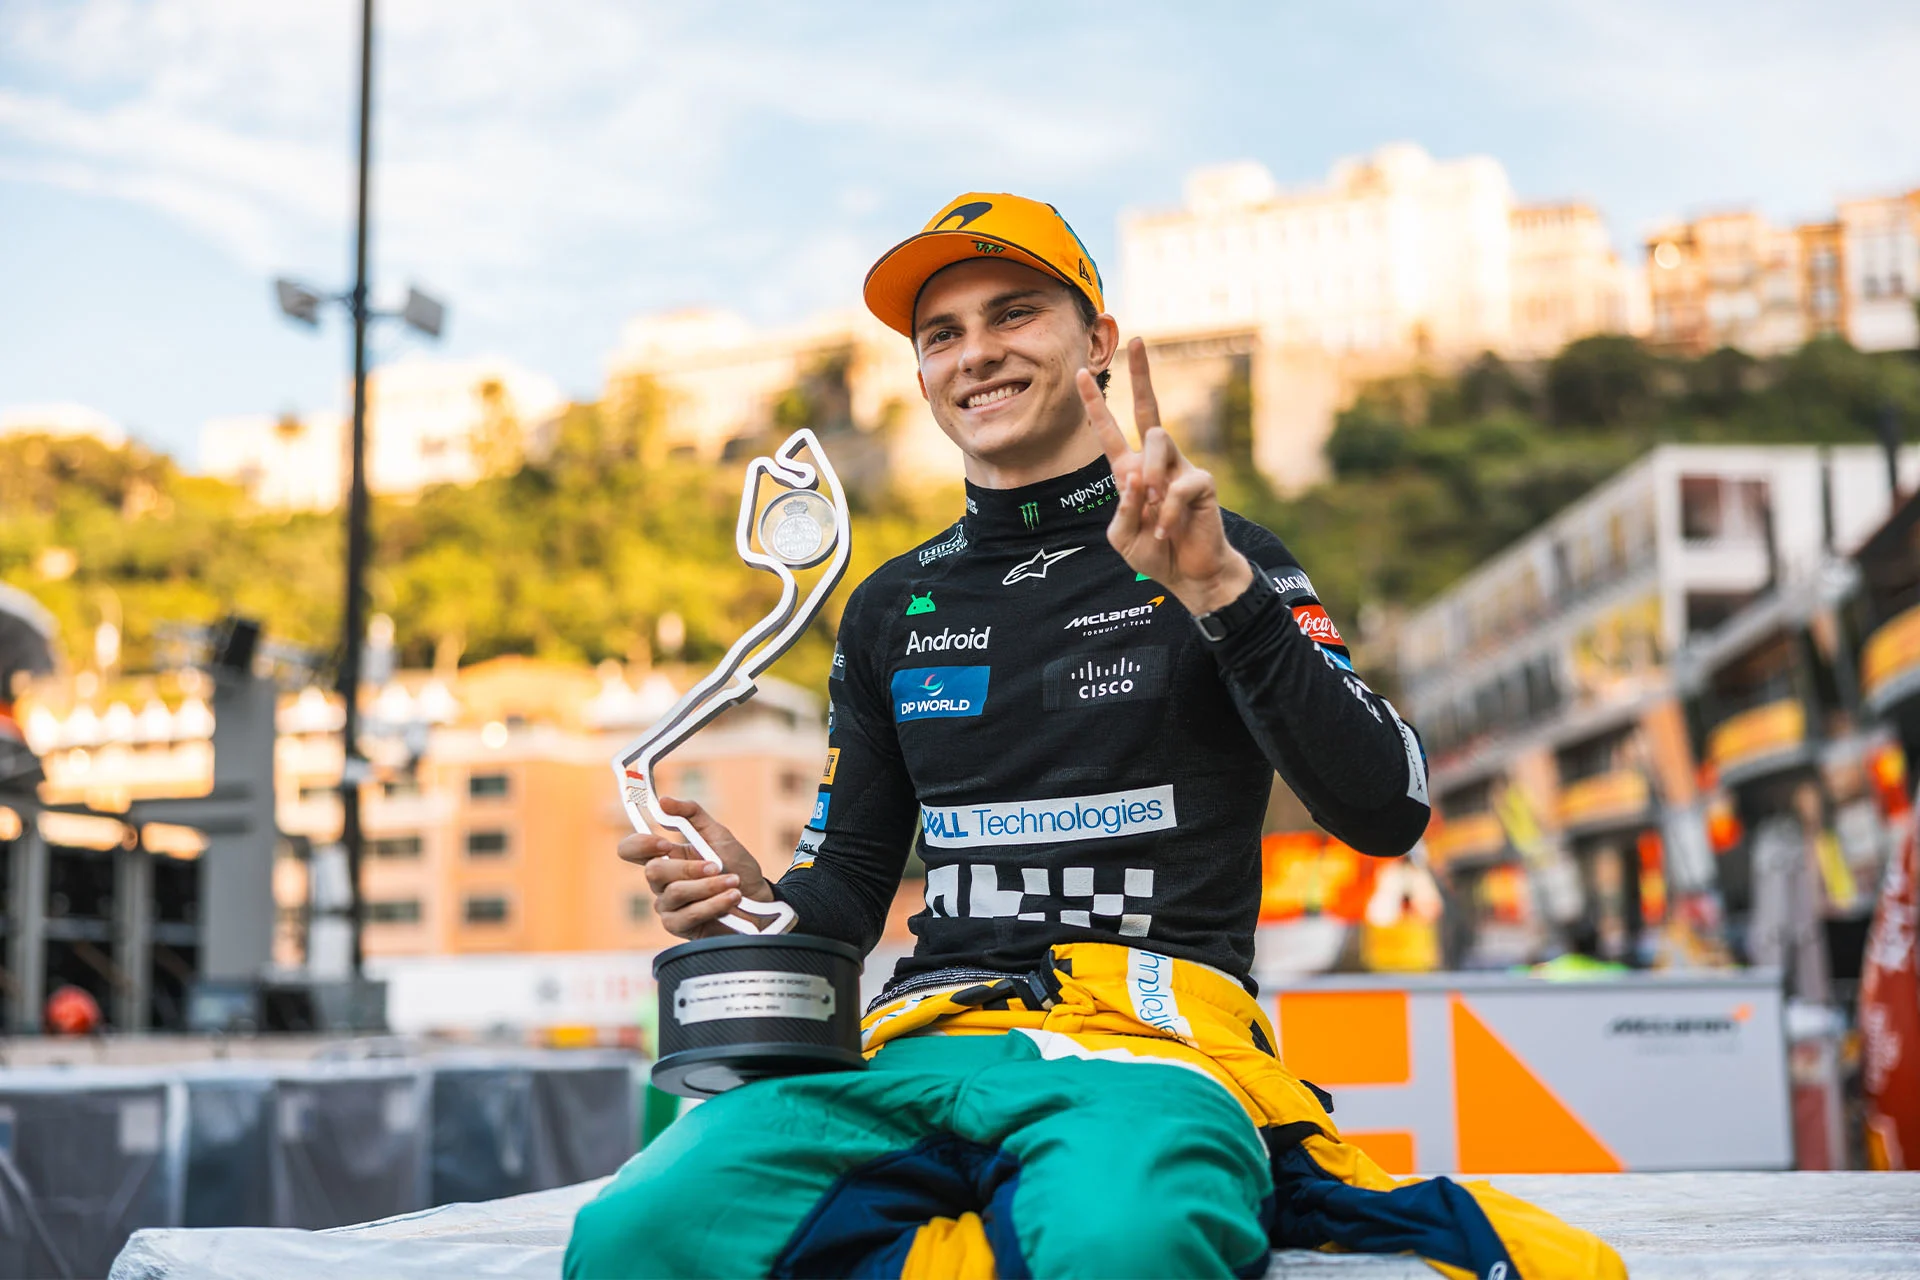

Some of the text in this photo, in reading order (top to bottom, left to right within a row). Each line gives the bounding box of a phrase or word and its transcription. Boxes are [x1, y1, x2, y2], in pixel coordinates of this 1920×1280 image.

[1078, 491, 1118, 513] ENERG
[1064, 604, 1153, 629] McLaren
[1083, 625, 1118, 636] FORMULA
[1130, 619, 1151, 627] TEAM
[906, 626, 991, 656] Android
[1079, 679, 1134, 699] CISCO
[901, 699, 970, 715] DP WORLD
[921, 799, 1163, 838] DELL Technologies
